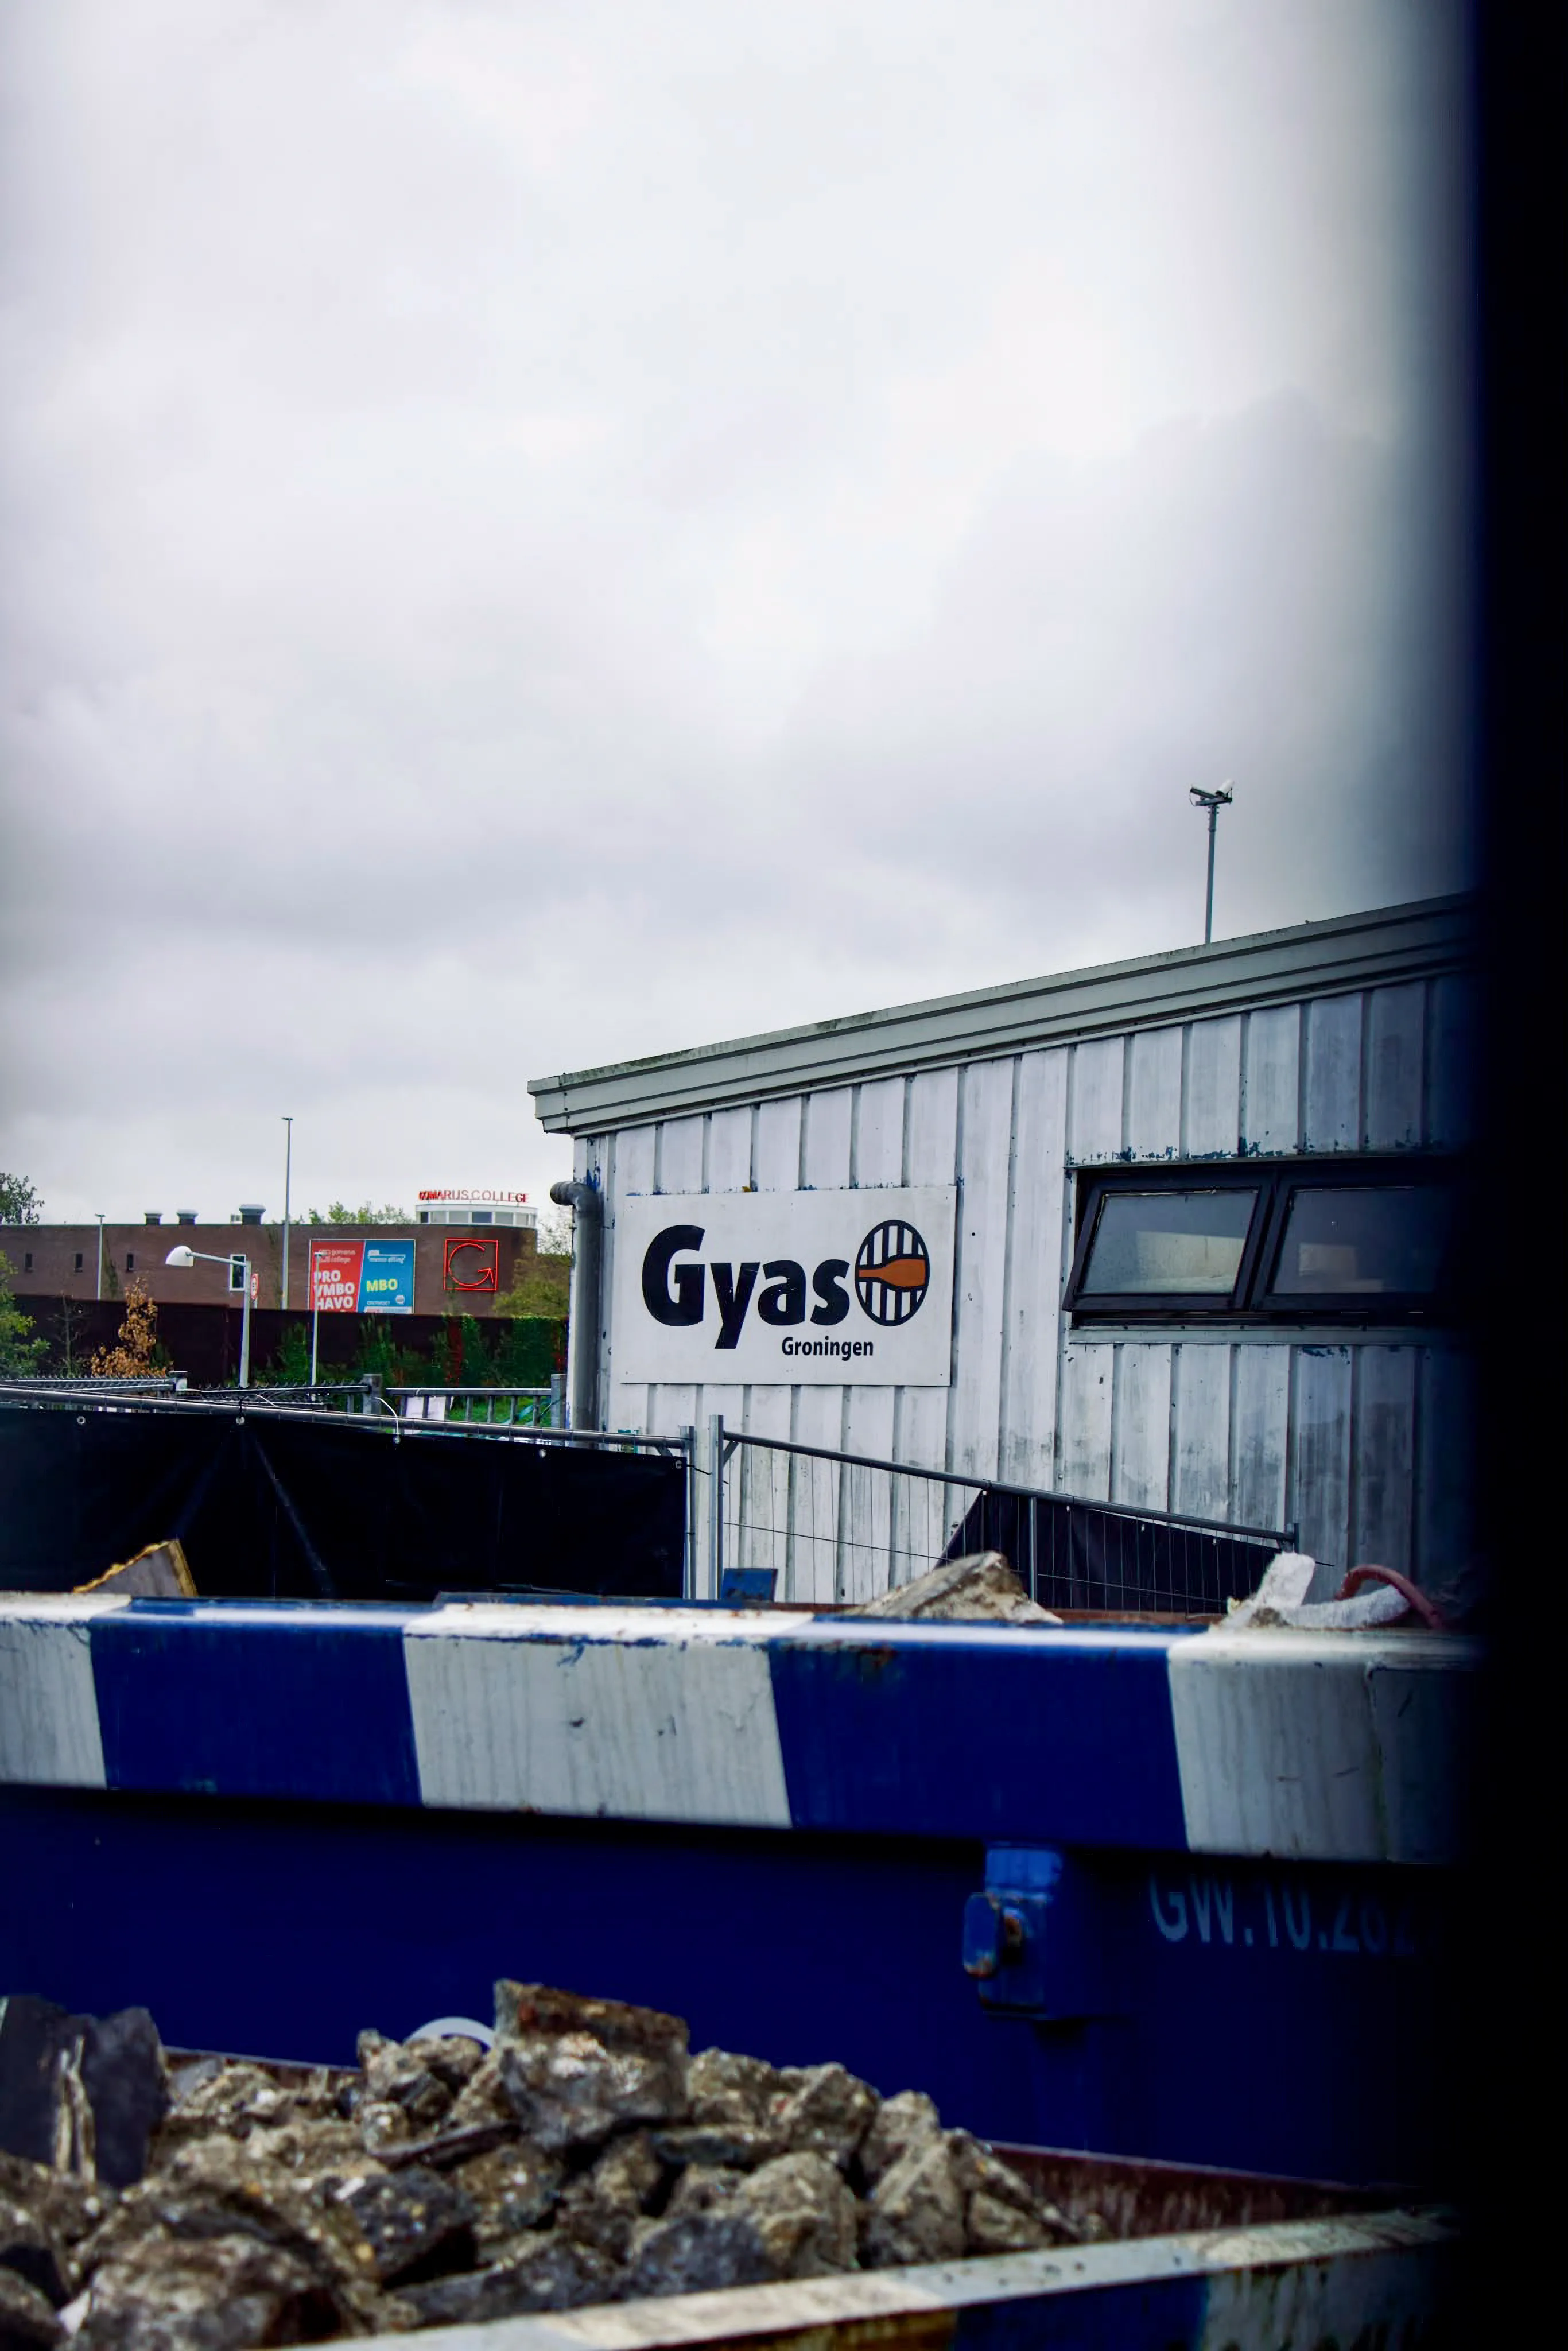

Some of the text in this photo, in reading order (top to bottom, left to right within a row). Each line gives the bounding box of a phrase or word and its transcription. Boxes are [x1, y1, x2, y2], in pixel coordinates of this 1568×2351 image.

[471, 1190, 530, 1203] COLLEGE
[314, 1270, 341, 1283] PRO
[314, 1282, 355, 1297] VMBO
[367, 1279, 398, 1292] MBO
[642, 1224, 850, 1349] Gyas
[315, 1295, 354, 1310] HAVO
[781, 1336, 874, 1361] Groningen
